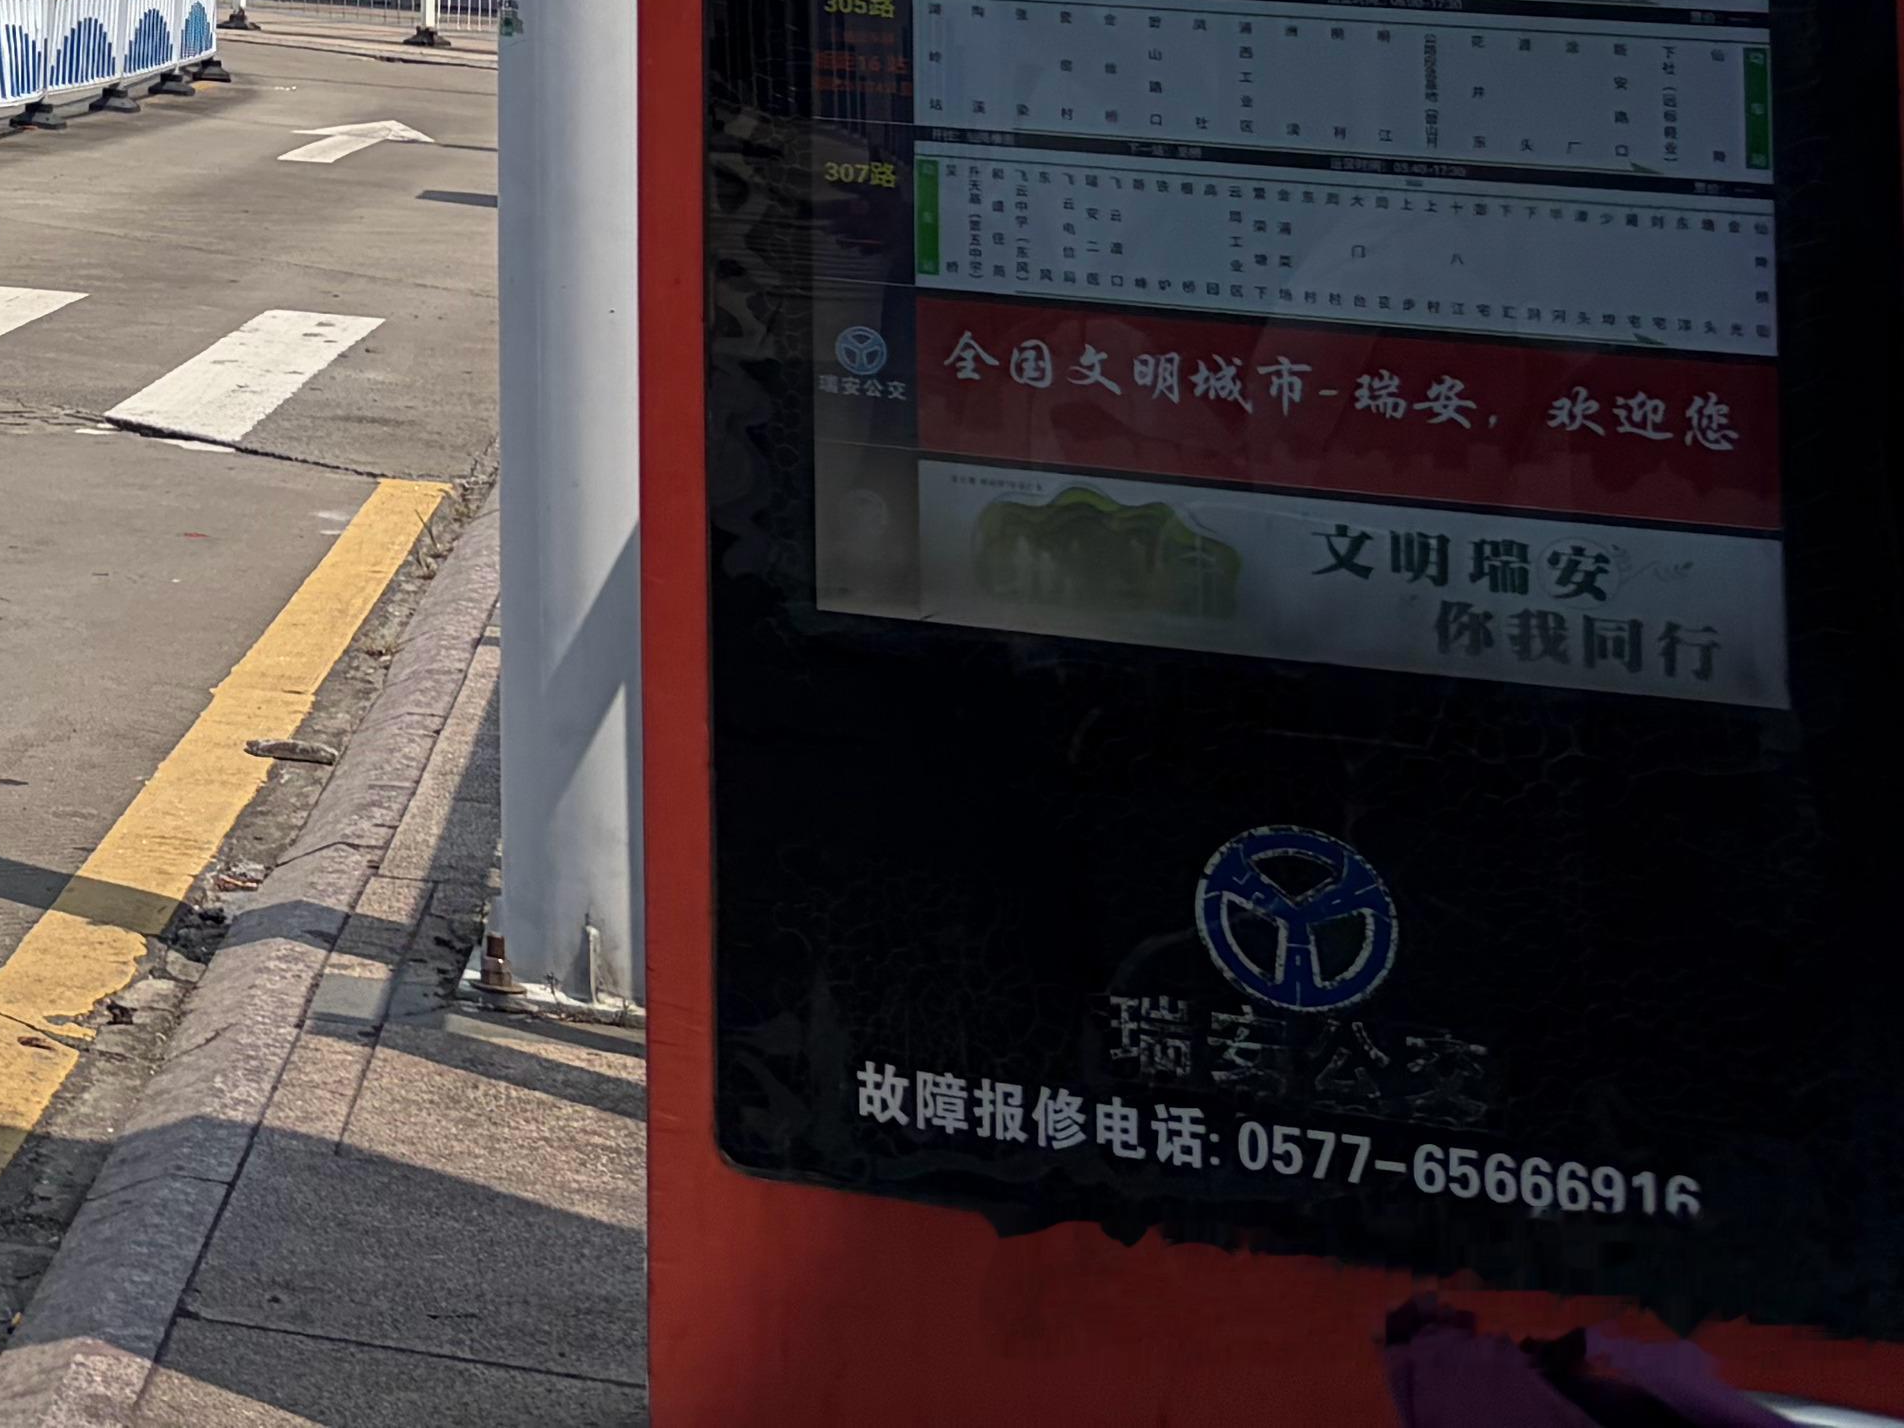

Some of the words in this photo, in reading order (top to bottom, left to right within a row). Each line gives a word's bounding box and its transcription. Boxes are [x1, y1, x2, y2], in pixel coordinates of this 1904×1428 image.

[824, 161, 896, 188] 307路
[818, 374, 907, 400] 瑞安公交
[1309, 521, 1618, 606] 文明瑞安
[1432, 598, 1721, 682] 你我同行
[857, 1055, 1228, 1168] 故障报修电话:
[1238, 1114, 1700, 1217] 0577-65666916
